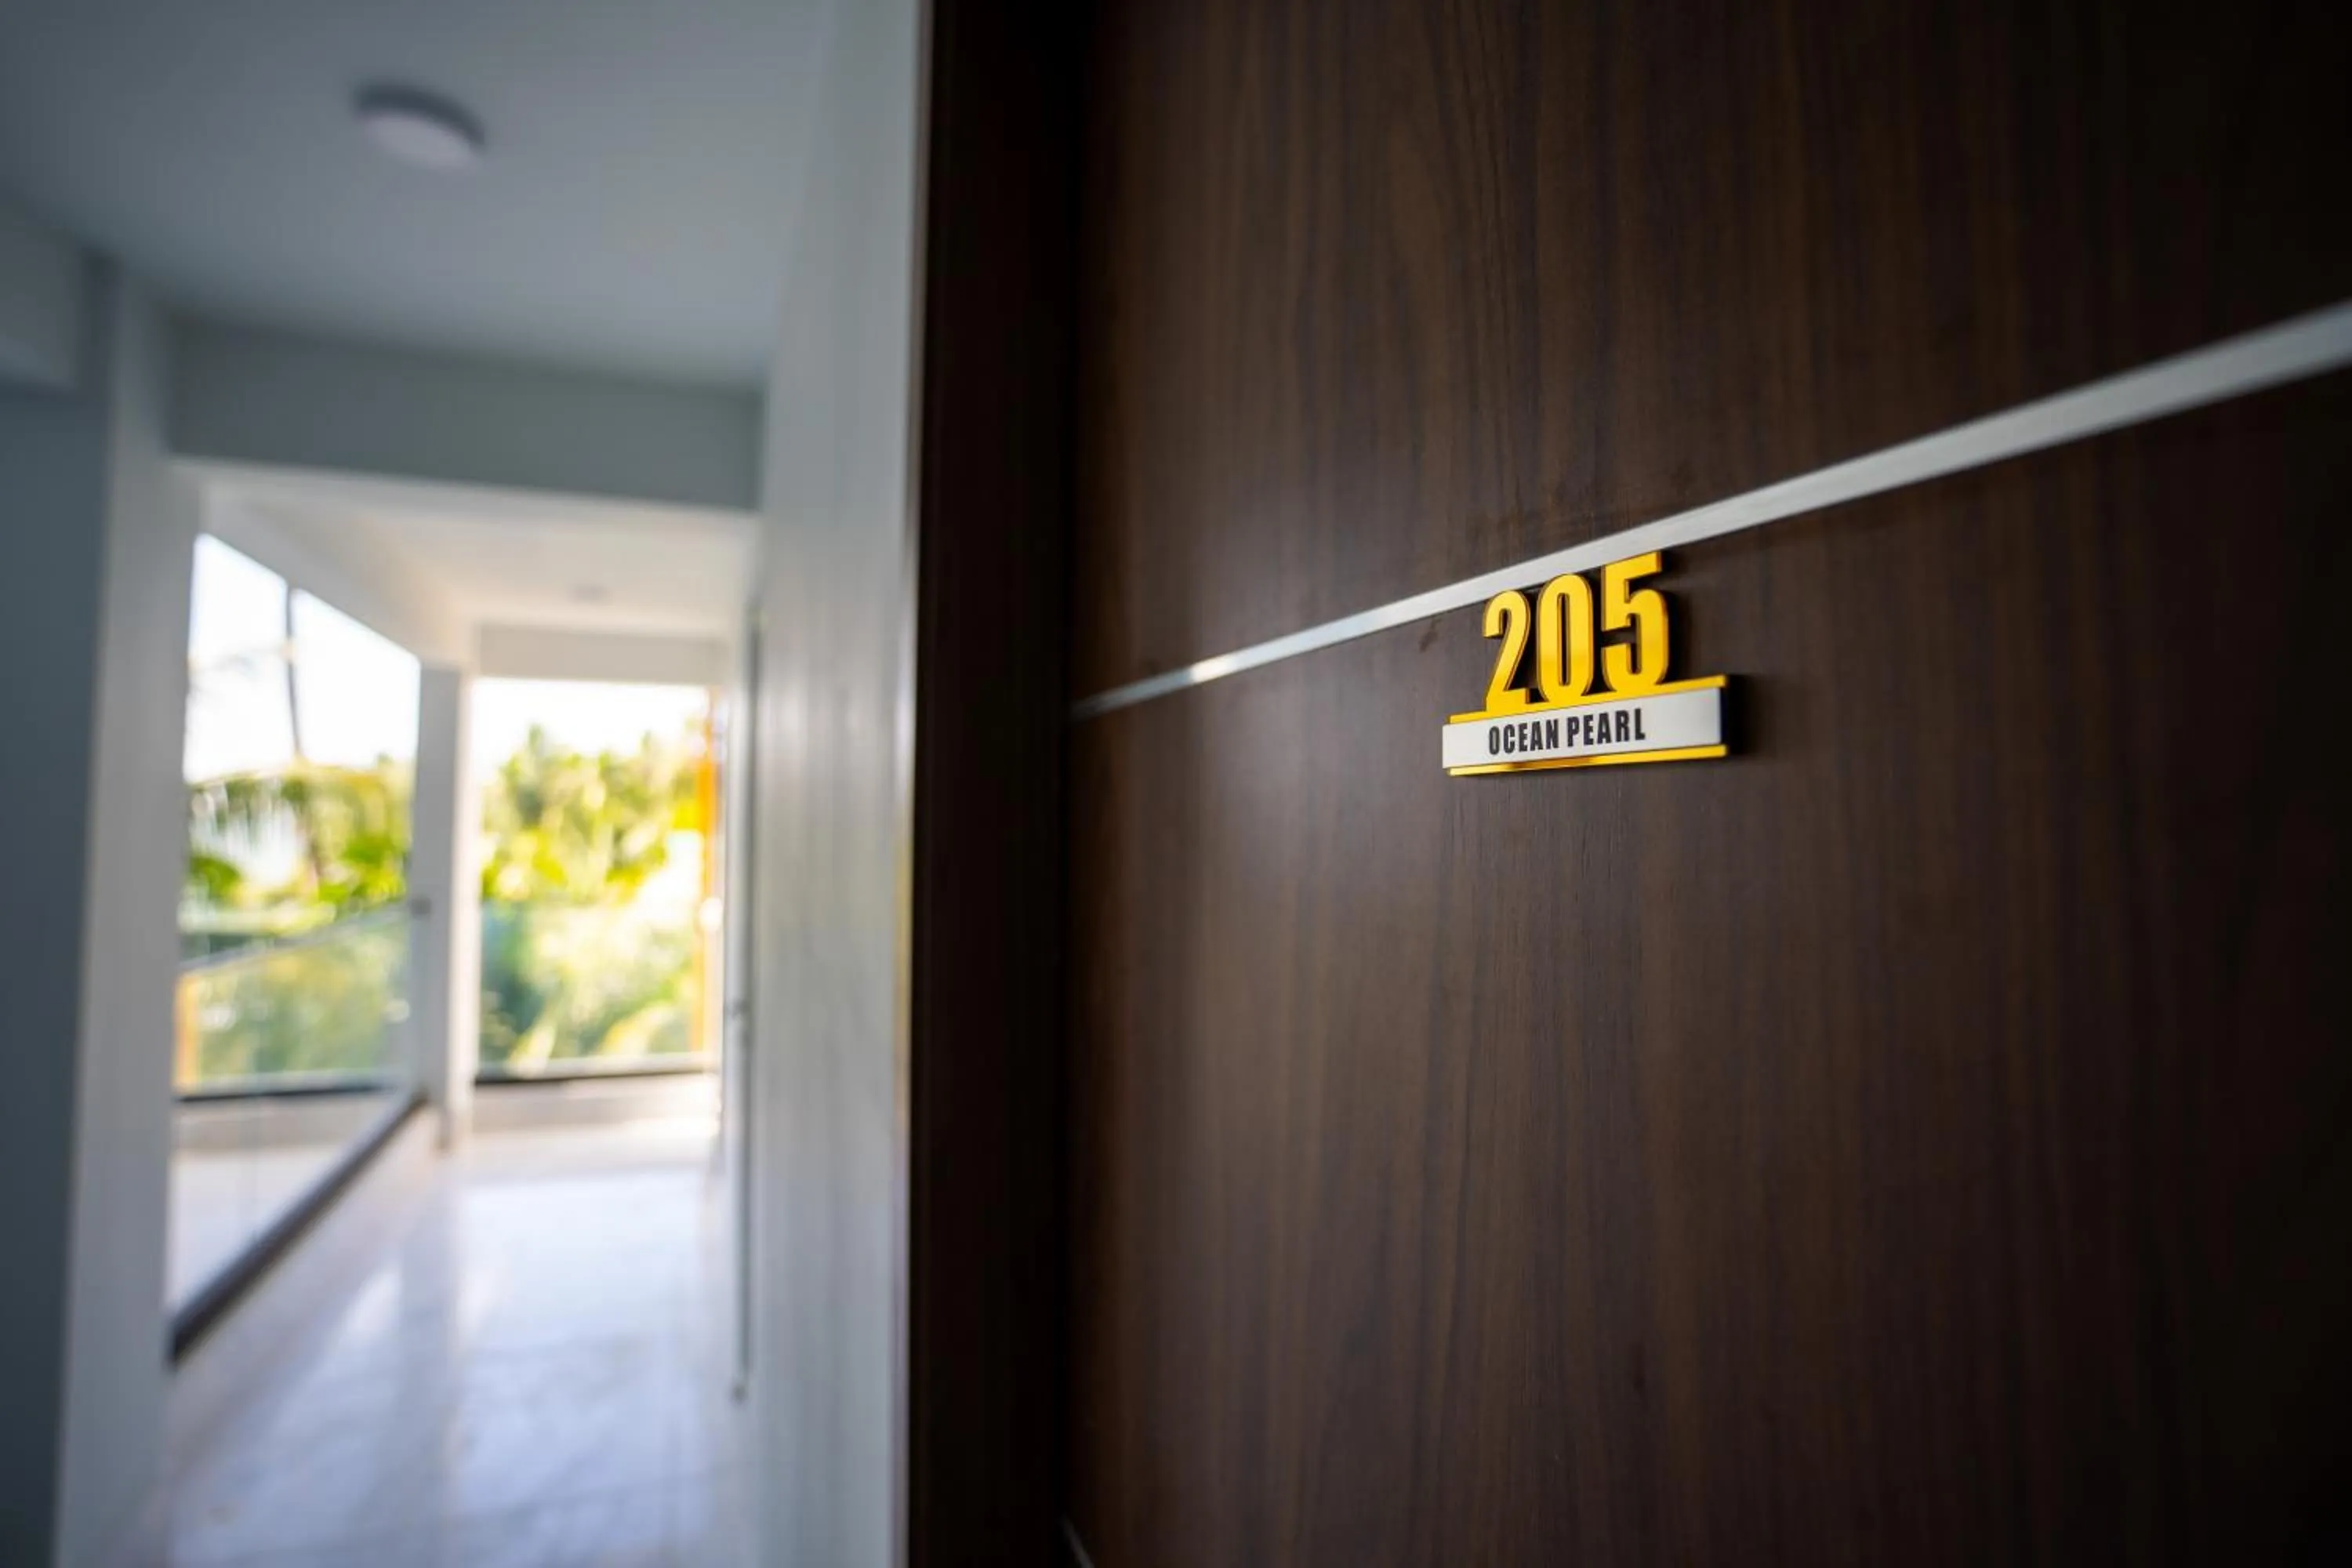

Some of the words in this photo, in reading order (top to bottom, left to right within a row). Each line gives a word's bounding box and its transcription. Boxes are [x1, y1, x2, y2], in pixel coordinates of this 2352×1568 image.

[1483, 551, 1669, 712] 205
[1489, 719, 1559, 755] OCEAN
[1567, 708, 1646, 746] PEARL
